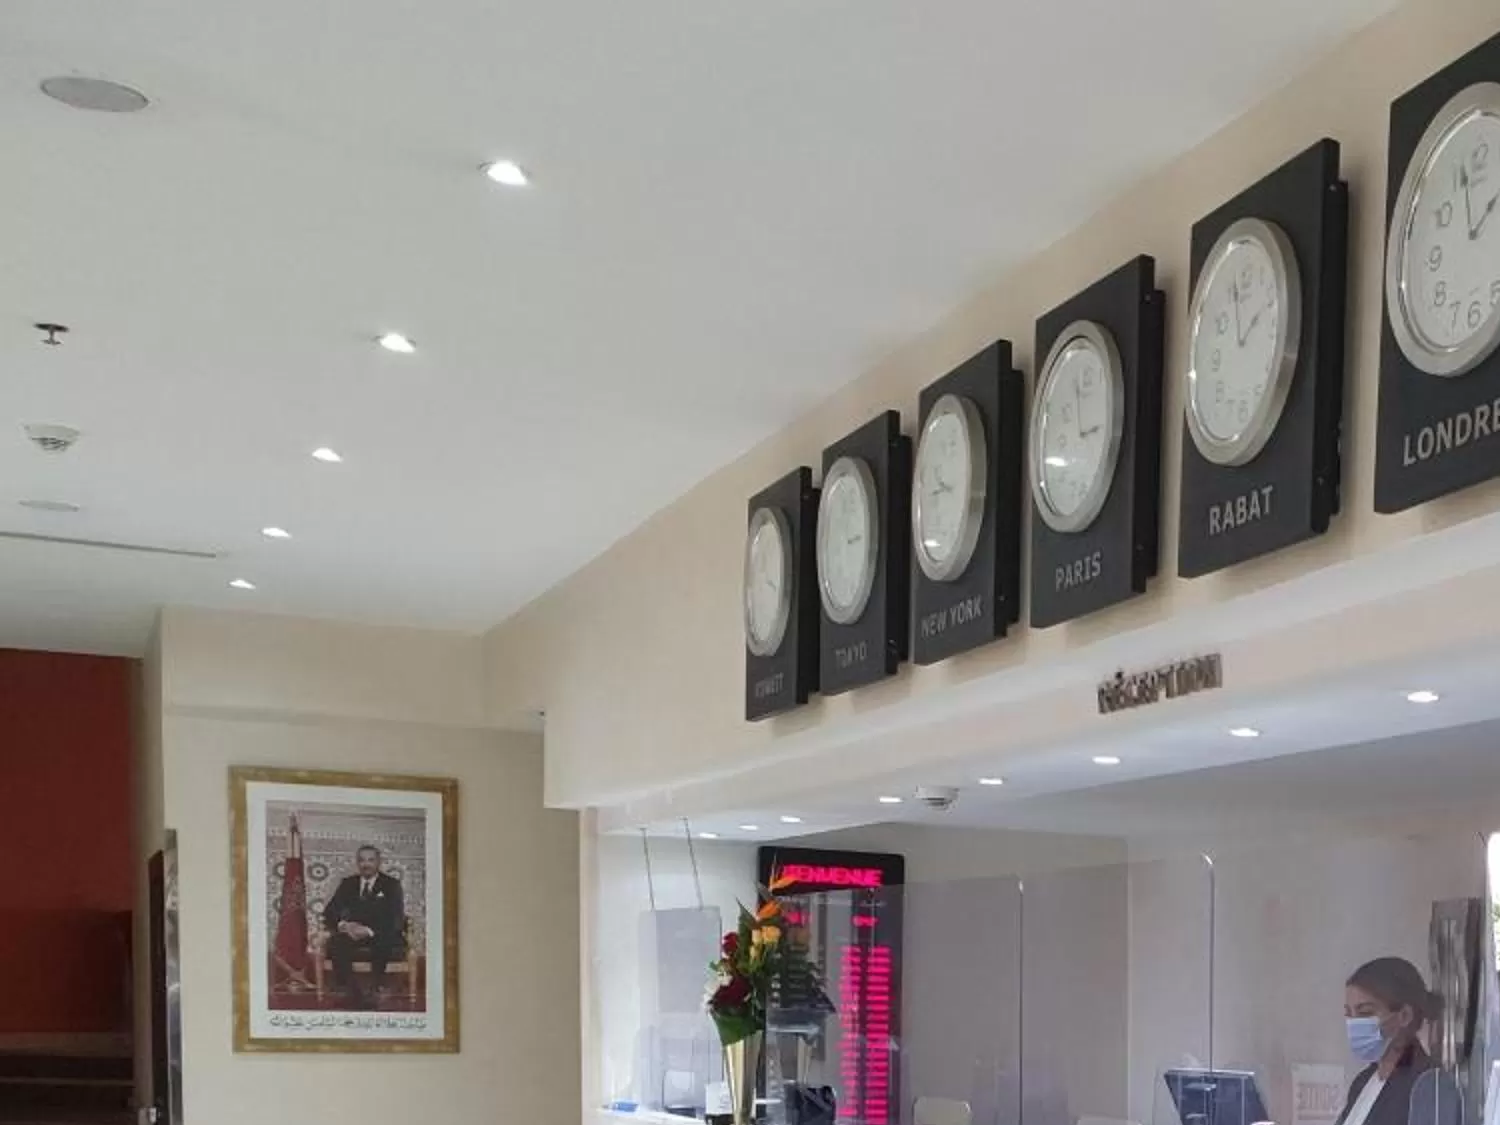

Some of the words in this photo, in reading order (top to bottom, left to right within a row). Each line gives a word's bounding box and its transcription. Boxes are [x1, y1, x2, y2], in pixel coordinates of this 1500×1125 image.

[1428, 244, 1442, 272] 9
[1433, 279, 1447, 307] 8
[1466, 299, 1481, 328] 6
[1208, 485, 1273, 536] RABAT
[1055, 551, 1101, 592] PARIS
[920, 609, 948, 638] NEW
[949, 594, 982, 628] YORK
